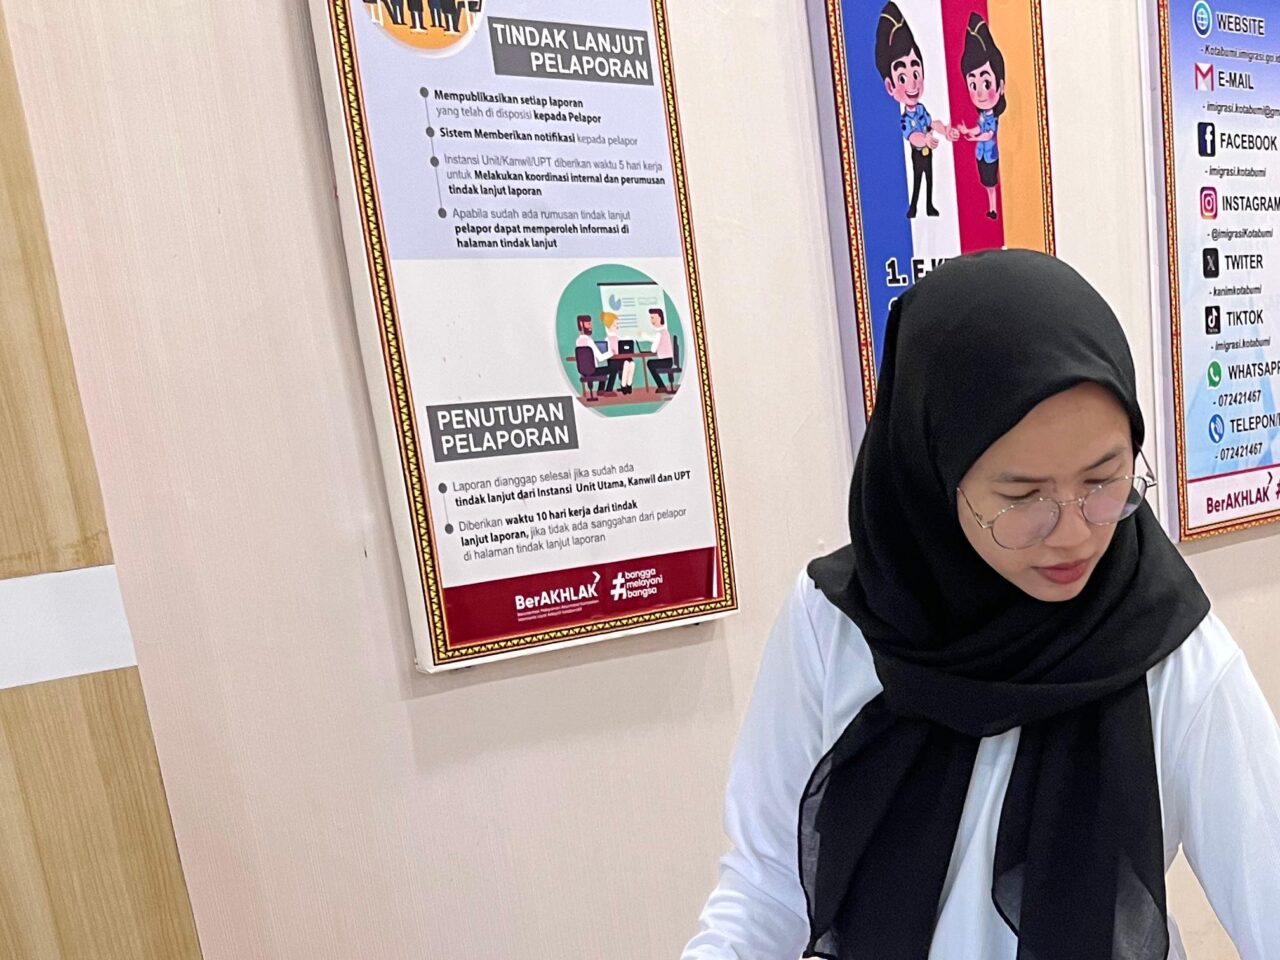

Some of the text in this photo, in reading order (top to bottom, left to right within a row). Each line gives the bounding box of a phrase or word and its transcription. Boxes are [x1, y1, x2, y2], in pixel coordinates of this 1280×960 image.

[1216, 13, 1266, 36] WEBSITE
[492, 23, 645, 56] TINDAK LANJUT
[530, 51, 649, 80] PELAPORAN
[1218, 71, 1255, 90] E-MAIL
[434, 90, 583, 110] Mempublikasikan setiap laporan
[436, 105, 602, 125] yang telah di disposisi kepada Pelapor
[439, 127, 638, 148] Sistem Memberikan notifikasi kepada pelapor
[1220, 132, 1279, 151] FACEBOOK
[444, 154, 480, 166] Instansi
[554, 157, 592, 169] diberikan
[593, 159, 617, 170] waktu
[618, 159, 625, 170] 5
[626, 160, 642, 171] hari
[642, 161, 663, 172] kerja
[446, 168, 666, 186] untuk Melakukan koordinasi internal dan perumusan
[448, 184, 542, 198] tindak lanjut laporan
[452, 208, 631, 222] Apabila sudah ada rumusan tindak lanjut
[454, 223, 629, 236] pelapor dapat memperoleh informasi di
[456, 237, 558, 250] halaman tindak lanjut
[886, 258, 908, 286] 1.
[1224, 254, 1264, 271] TWITER
[1226, 309, 1264, 327] TIKTOK
[436, 402, 564, 431] PENUTUPAN
[440, 425, 570, 456] PELAPORAN
[452, 463, 635, 494] Laporan dianggap selesai jika sudah ada
[455, 470, 691, 507] tindak lanjut dari Instansi Unit Utama, Kanwil dan UPT
[1206, 485, 1270, 515] BerAKHLAK
[458, 499, 638, 532] Diberikan waktu 10 hari kerja dari tindak
[460, 507, 687, 548] lanjut laporan, jika tidak ada sanggahan dari pelapor
[463, 533, 606, 562] di halaman tindak lanjut laporan
[624, 567, 657, 580] bangga
[626, 575, 663, 588] melayani
[514, 582, 599, 611] BerAKHLAK
[626, 586, 658, 598] bangsa
